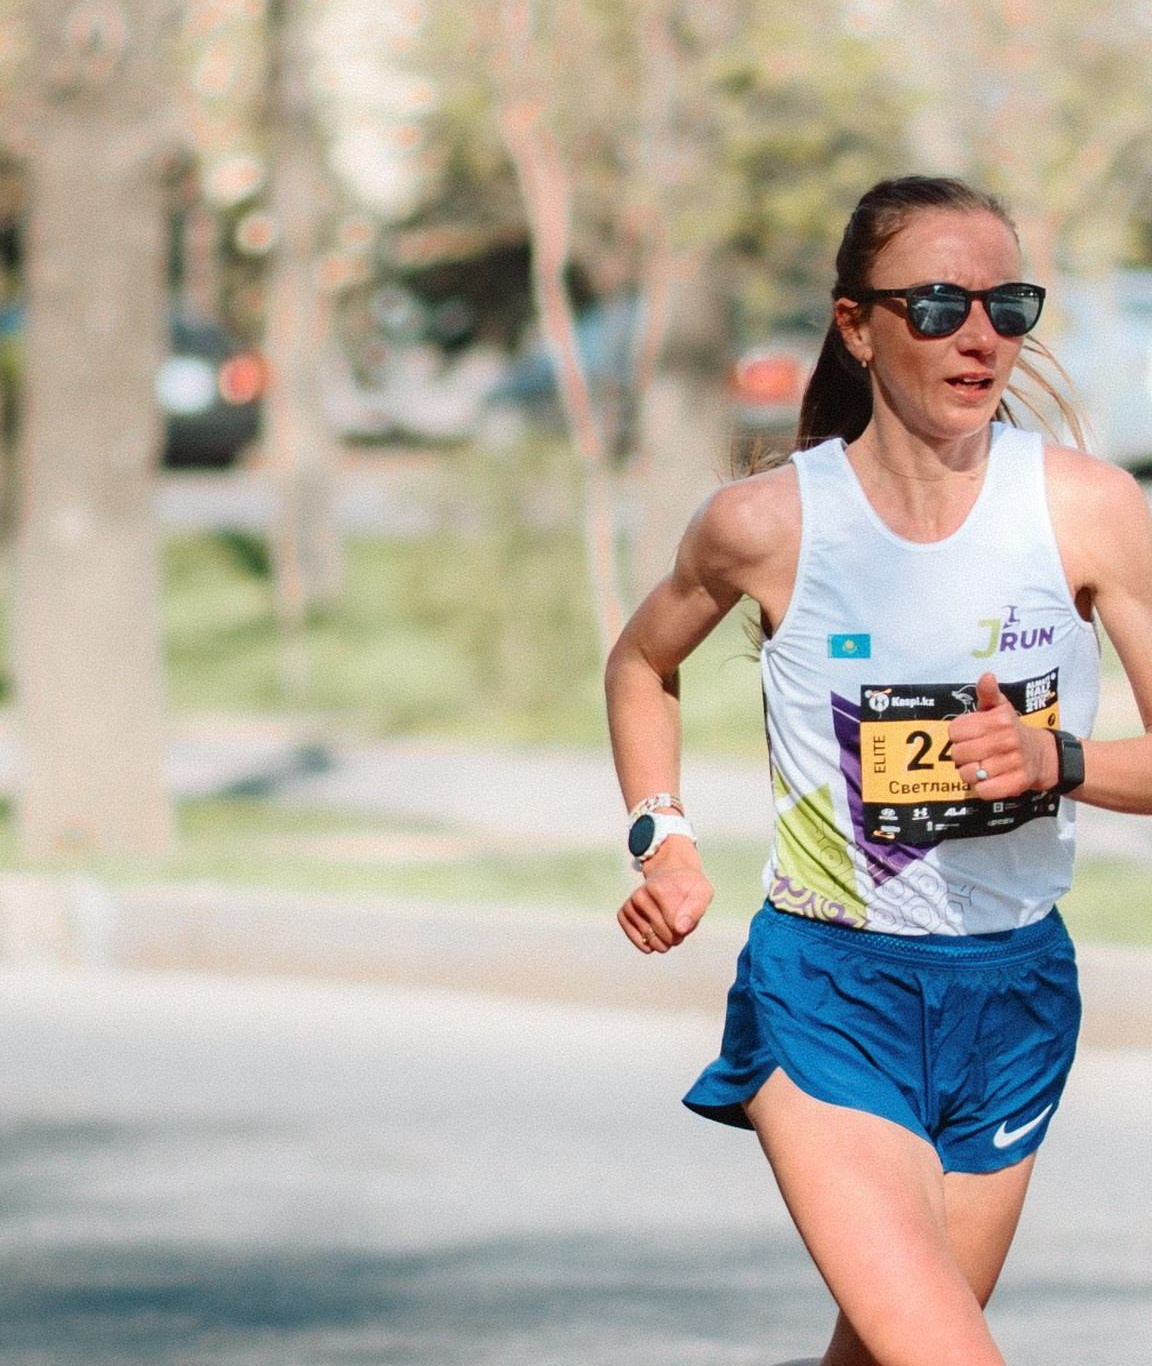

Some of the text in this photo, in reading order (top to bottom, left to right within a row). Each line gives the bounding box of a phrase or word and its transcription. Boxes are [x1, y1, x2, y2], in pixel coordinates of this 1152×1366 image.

[891, 696, 935, 708] Kaspi.kz
[873, 735, 886, 774] ELITE
[889, 780, 972, 795] Светлана
